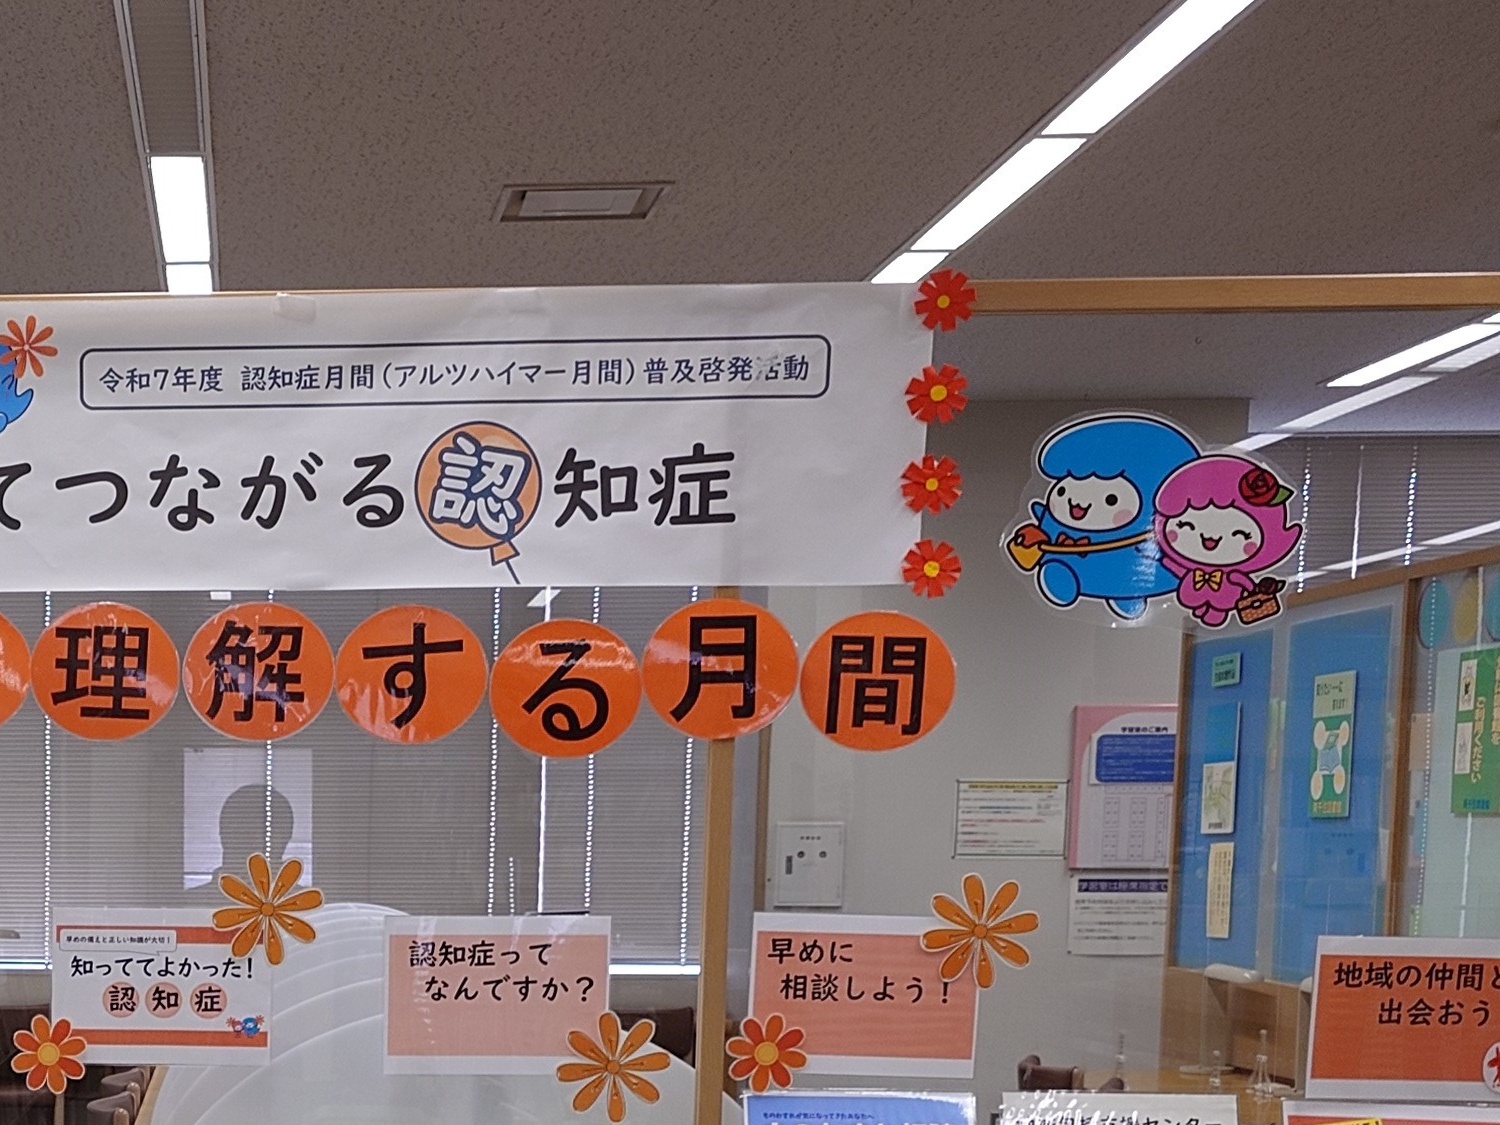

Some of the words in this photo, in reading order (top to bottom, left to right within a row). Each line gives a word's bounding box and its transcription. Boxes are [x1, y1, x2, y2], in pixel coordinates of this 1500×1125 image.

[99, 364, 223, 394] 令和7年度
[409, 940, 552, 967] 認知症って
[767, 937, 854, 965] 早めに
[108, 985, 224, 1014] 認知症
[425, 975, 595, 1003] なんですか？
[1378, 996, 1492, 1027] 出会おう
